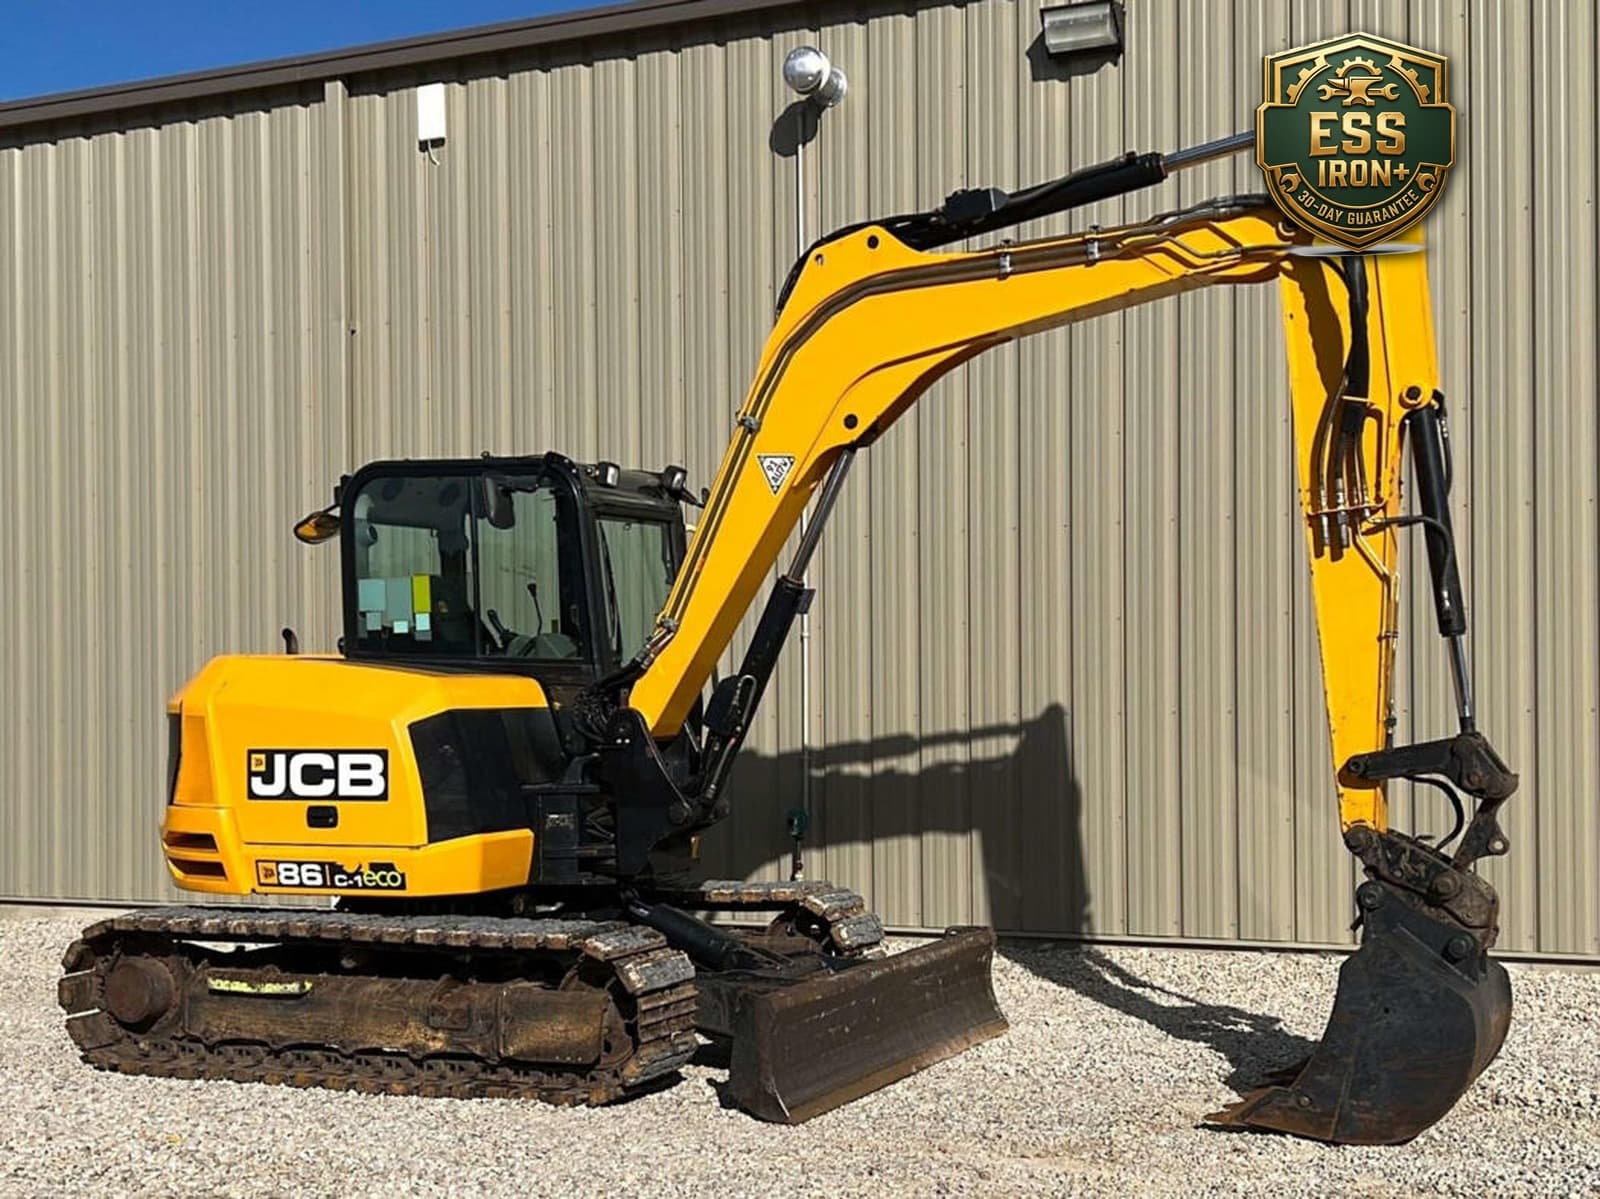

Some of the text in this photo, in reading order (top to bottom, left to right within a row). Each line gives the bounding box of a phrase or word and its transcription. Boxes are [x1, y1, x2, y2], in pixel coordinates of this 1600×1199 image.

[251, 753, 386, 797] JCB
[278, 862, 324, 887] 86
[363, 870, 402, 888] eco
